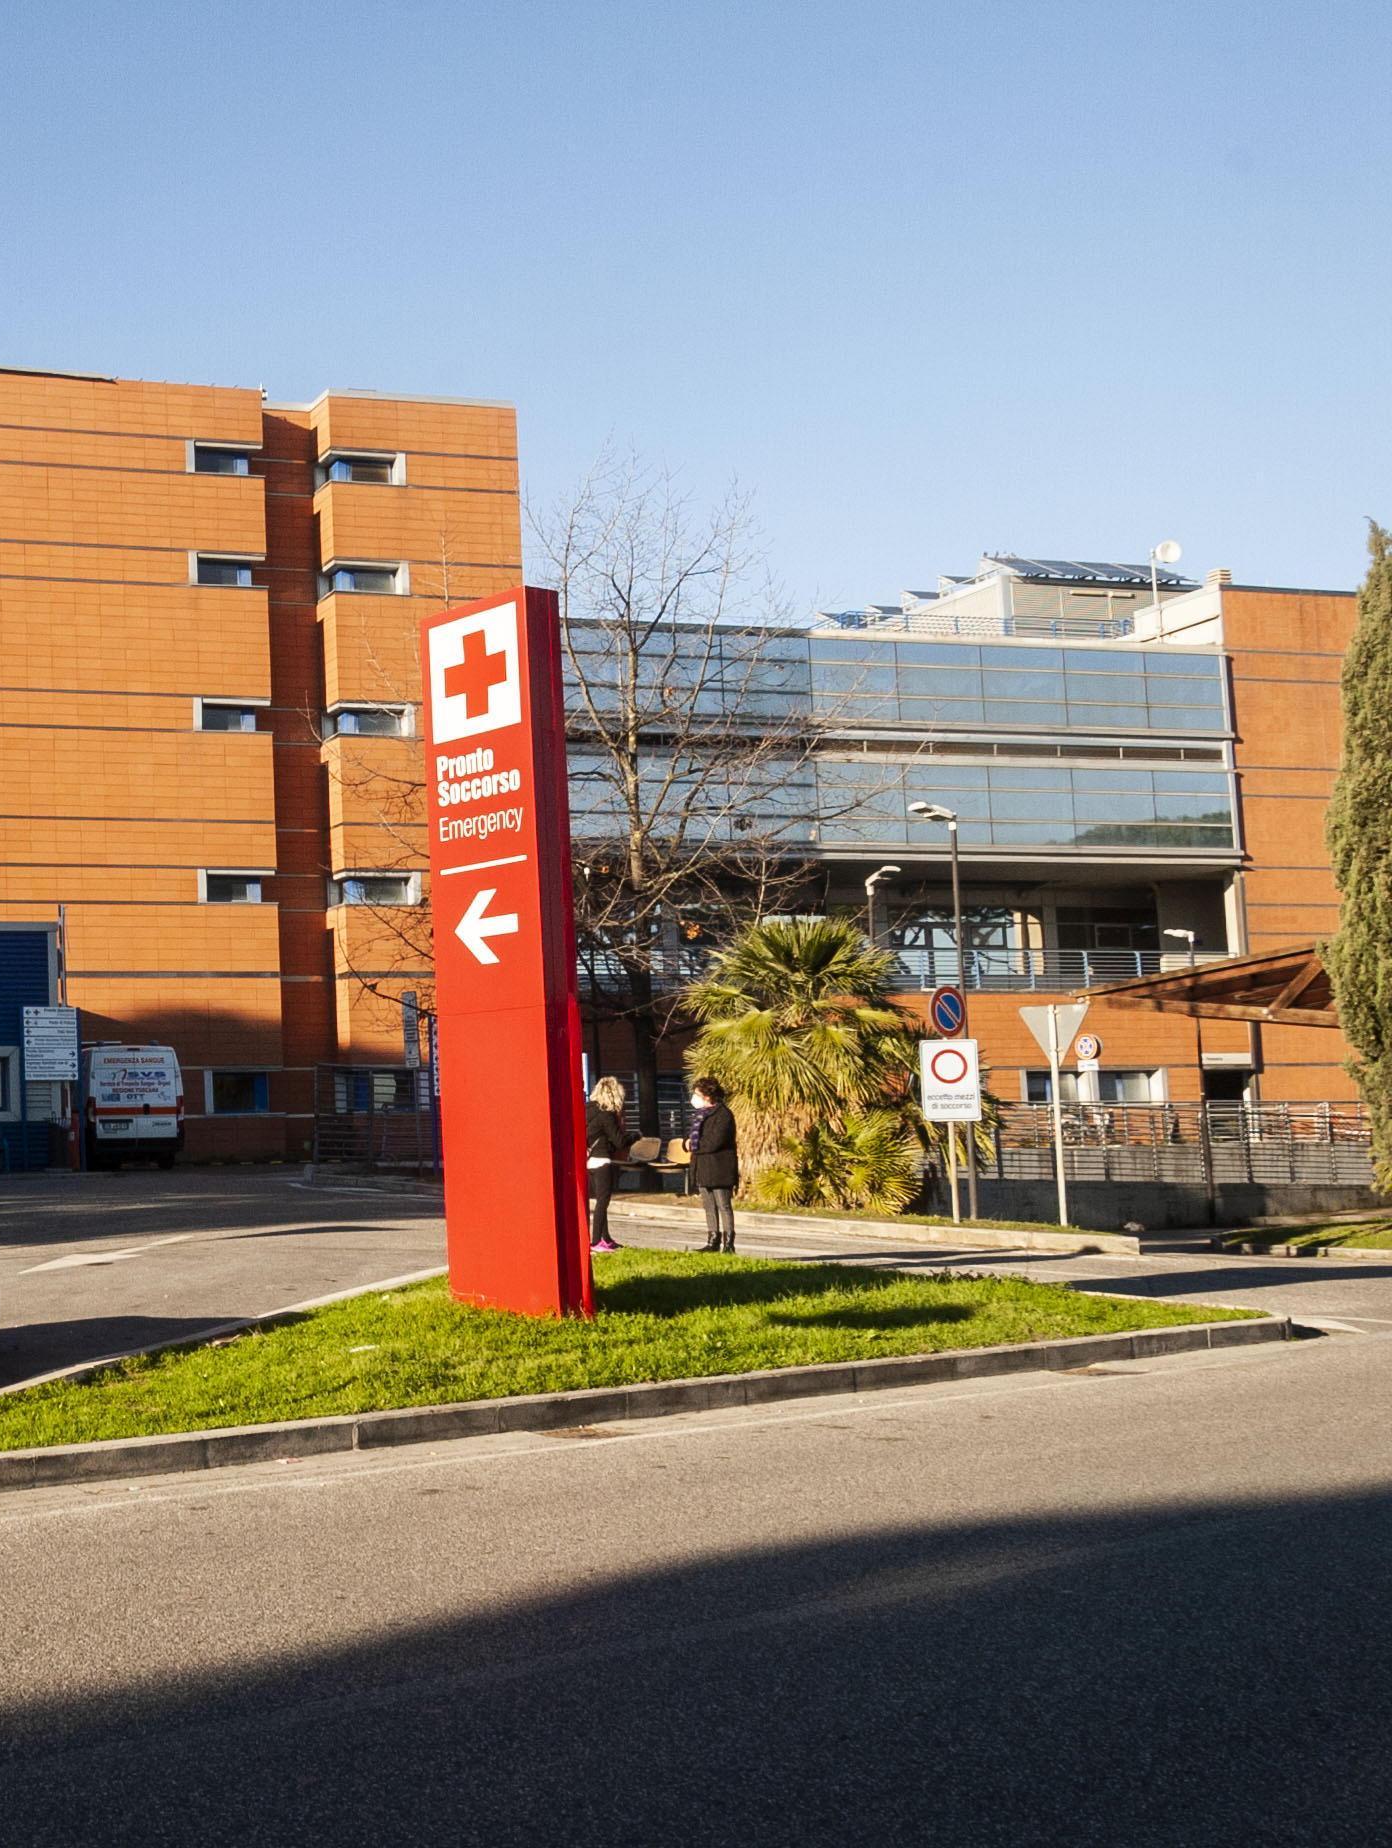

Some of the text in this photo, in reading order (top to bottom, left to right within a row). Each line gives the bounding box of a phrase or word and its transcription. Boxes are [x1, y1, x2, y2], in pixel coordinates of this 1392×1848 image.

[436, 747, 495, 782] Pronto
[437, 768, 521, 807] Soccorso
[439, 807, 524, 842] Emergency
